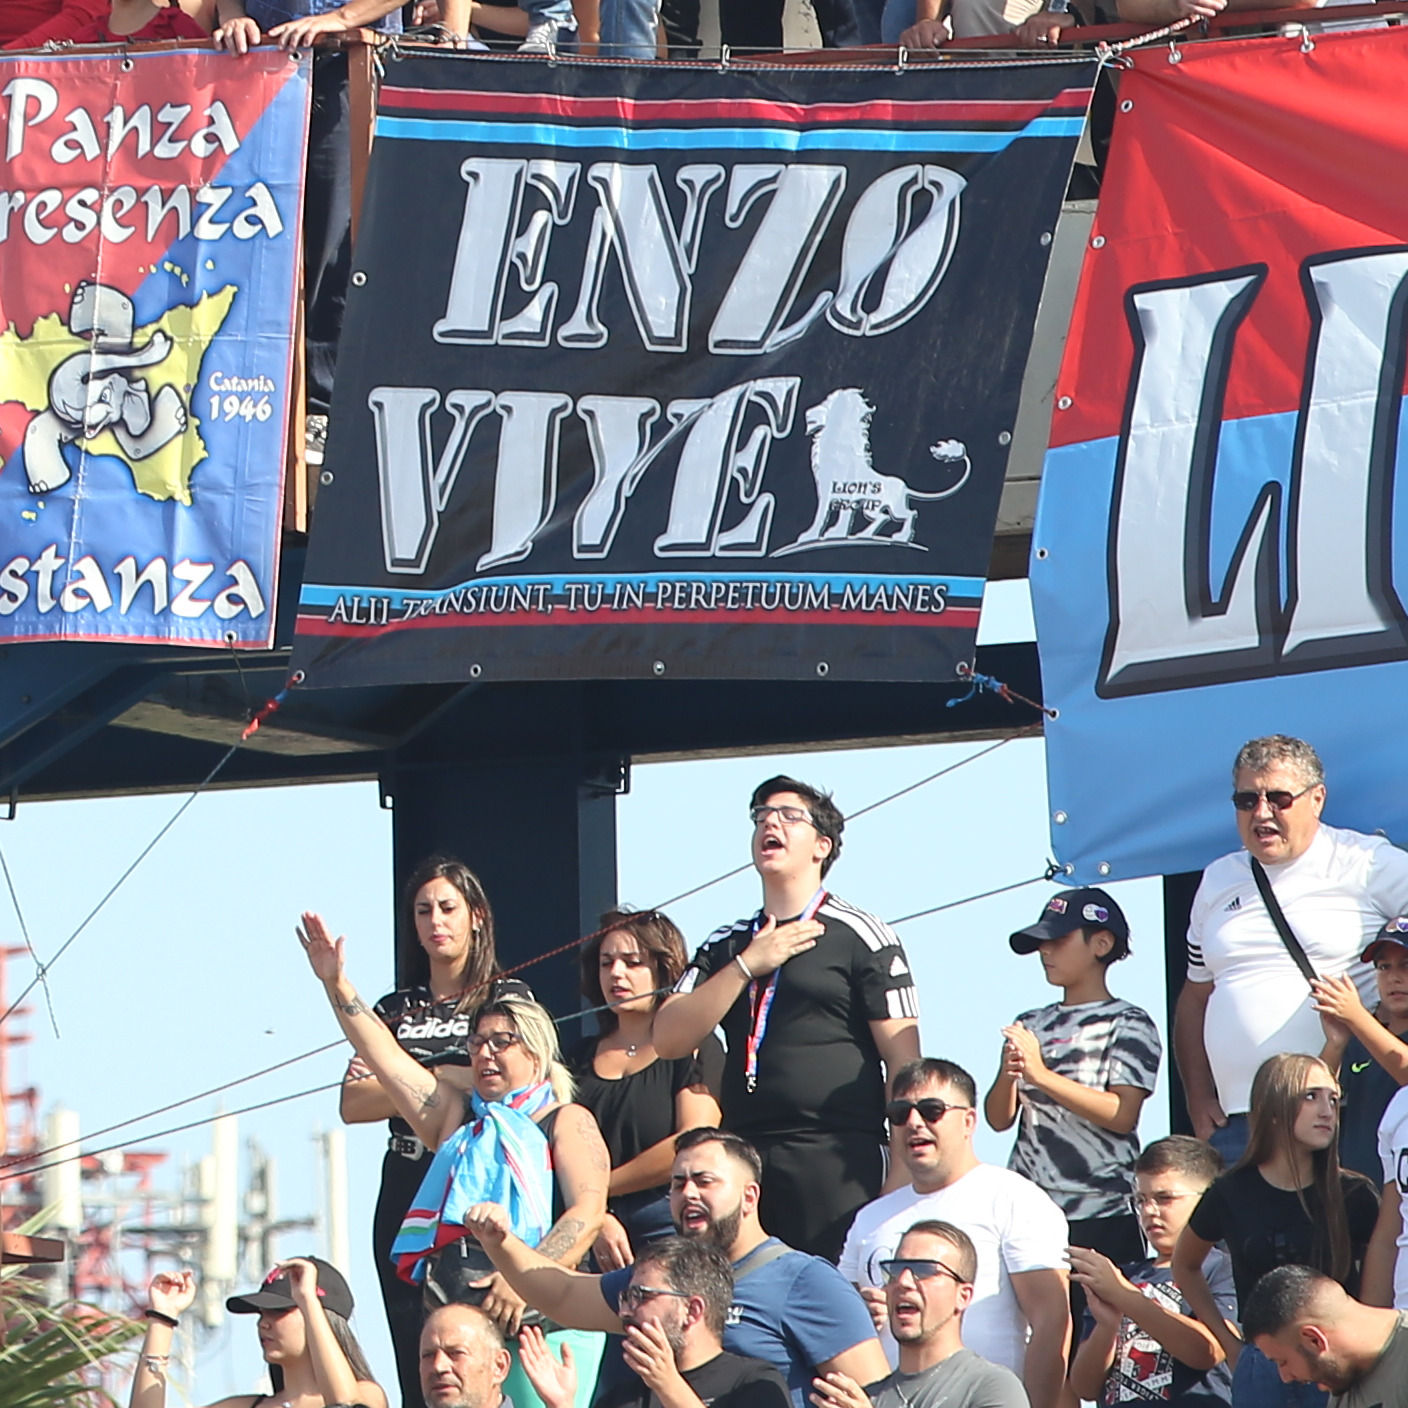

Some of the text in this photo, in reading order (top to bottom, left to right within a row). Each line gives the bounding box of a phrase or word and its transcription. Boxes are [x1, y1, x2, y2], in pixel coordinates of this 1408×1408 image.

[1, 77, 241, 166] Panza
[432, 155, 969, 356] ENZO
[208, 371, 276, 394] Catania
[208, 395, 273, 424] 1946
[329, 593, 389, 626] ALII
[565, 583, 603, 612] TU
[611, 581, 646, 611] IN
[655, 581, 832, 612] PERPETUUM
[839, 583, 948, 614] MANES
[396, 1019, 470, 1039] adida
